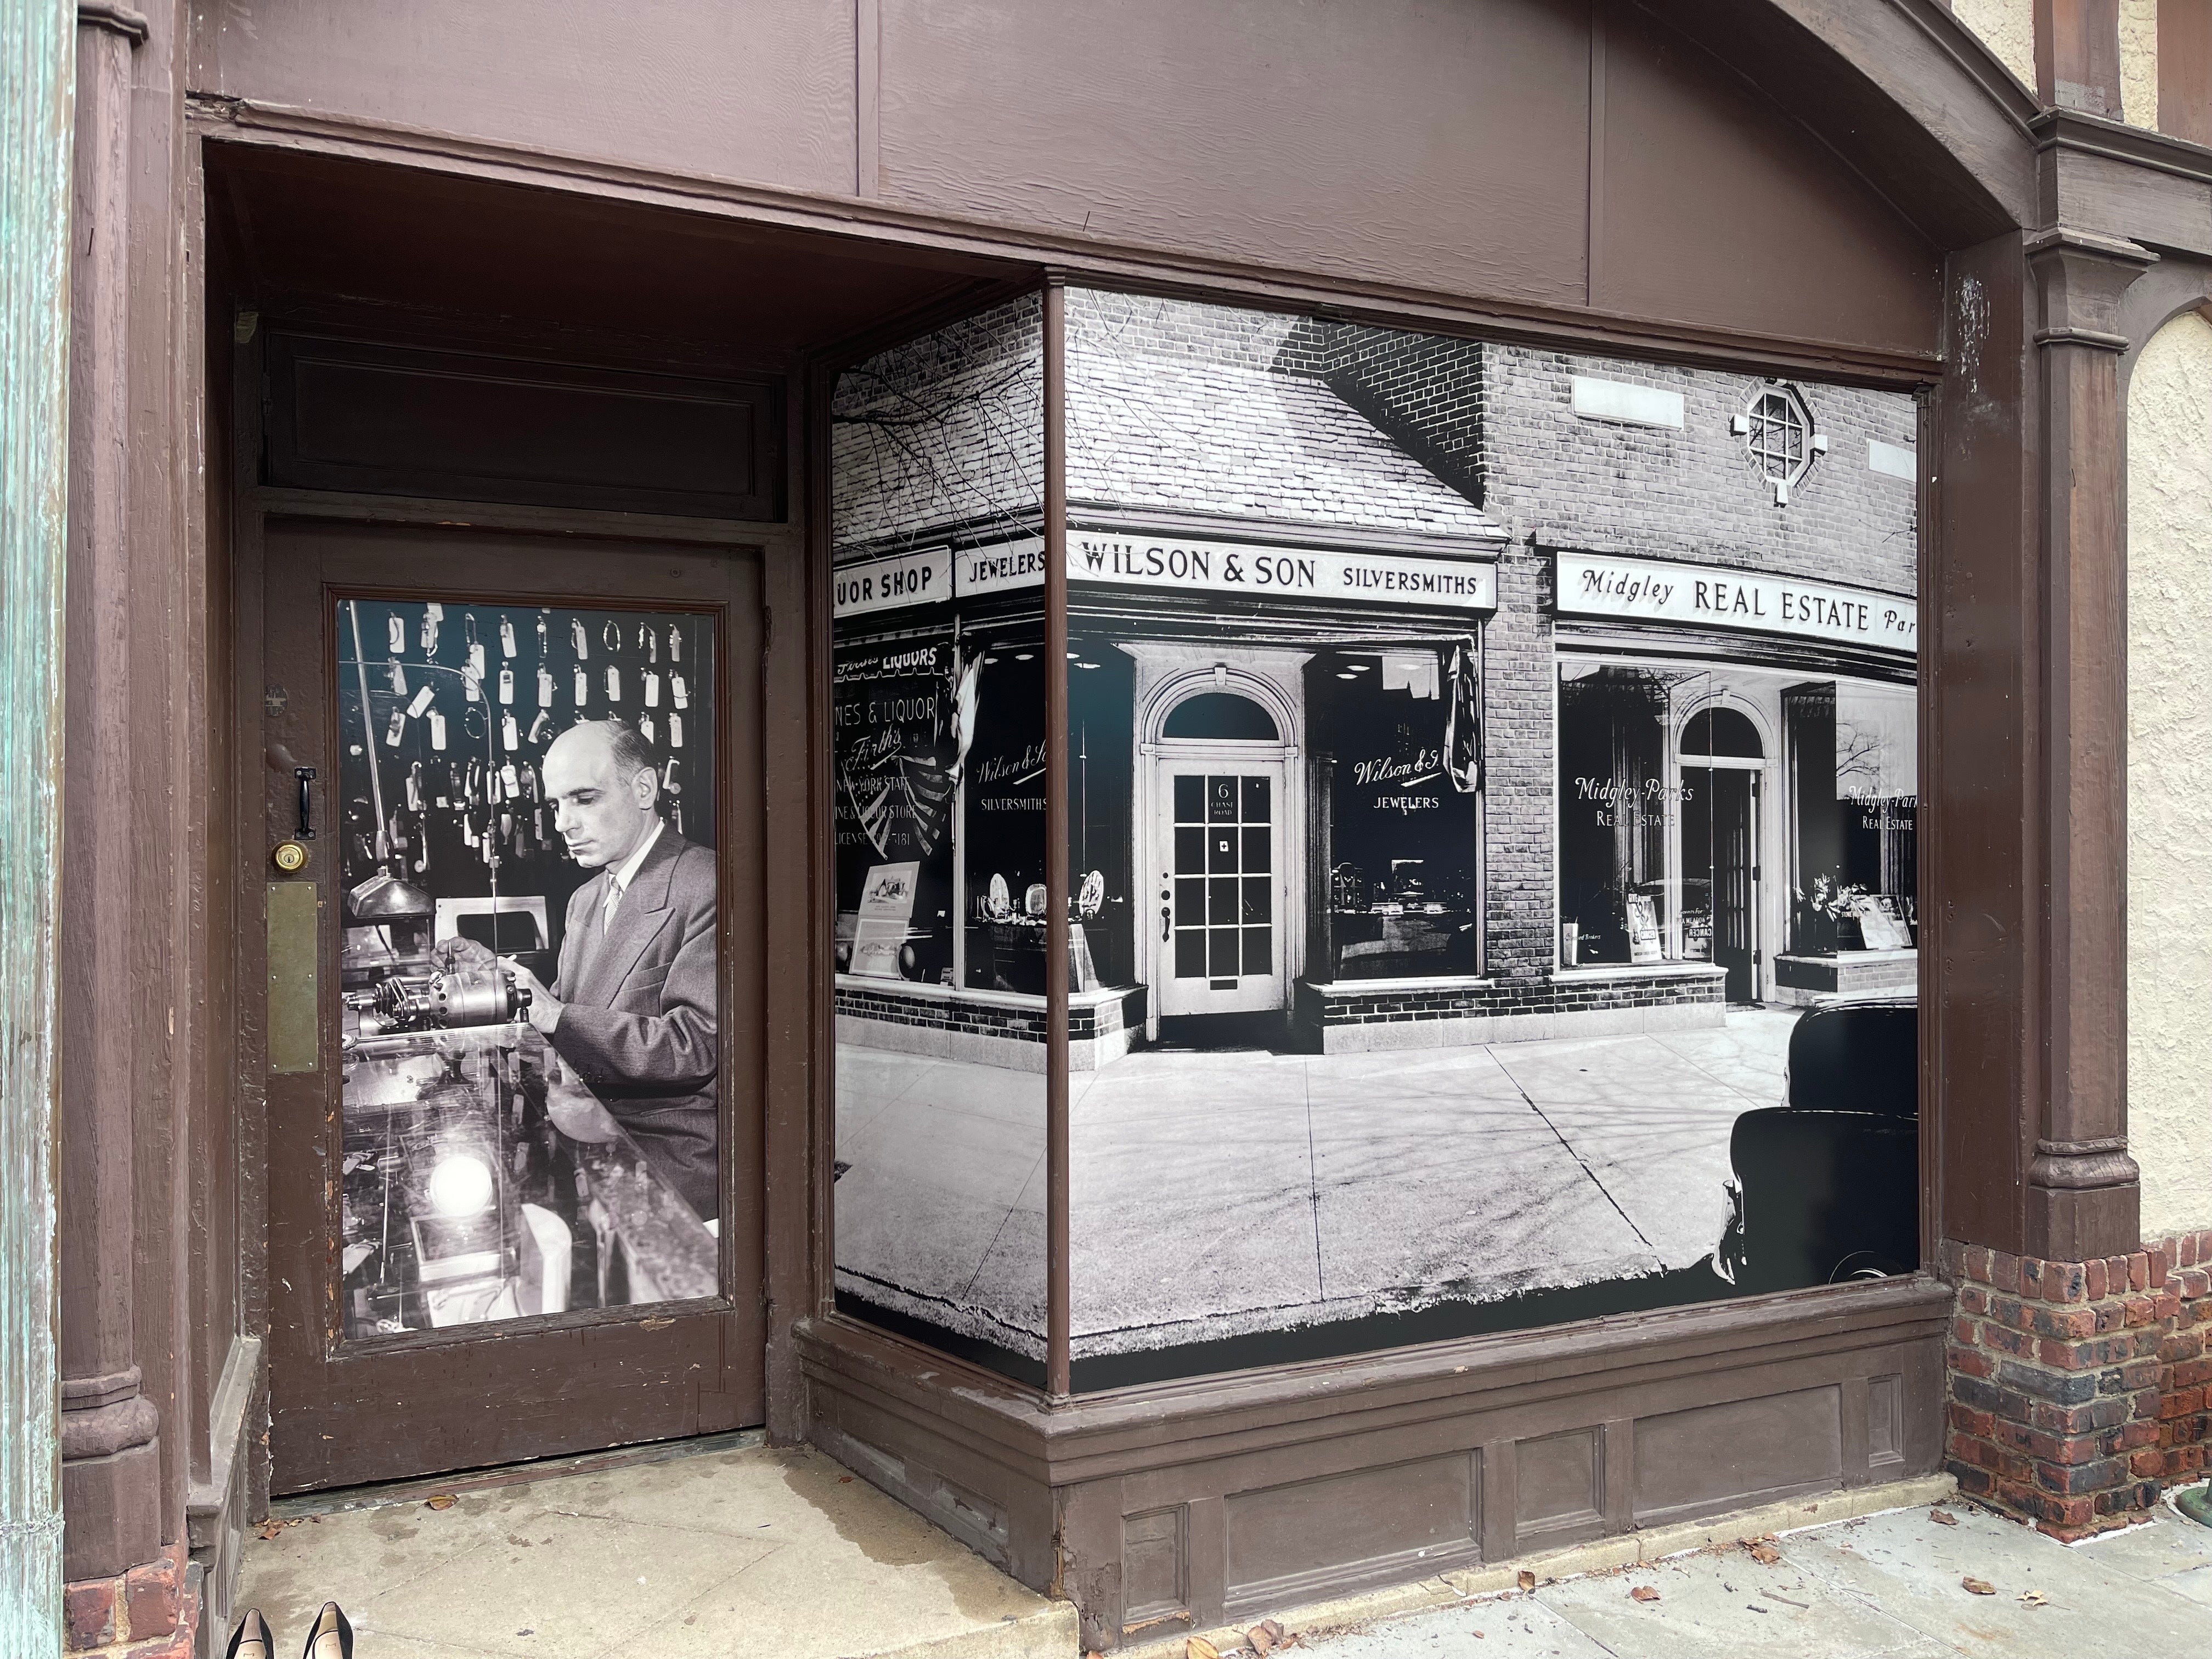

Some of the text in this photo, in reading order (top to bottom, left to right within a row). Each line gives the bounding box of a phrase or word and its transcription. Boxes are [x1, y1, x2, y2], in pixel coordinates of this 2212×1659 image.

[969, 551, 1045, 582] JEWELERS
[1082, 541, 1477, 595] WILSON & SON SILVERSMITHS
[837, 566, 932, 605] UOR SHOP
[1582, 569, 1916, 634] Midgley REAL ESTATE Par
[868, 702, 878, 724] &
[977, 755, 1019, 784] Wilson
[1354, 757, 1411, 786] Wilson
[859, 777, 882, 792] YORK
[1218, 783, 1228, 798] 6
[1575, 777, 1694, 808] Midgley-Parks
[981, 798, 1046, 811] SILVERSMITHS
[1373, 797, 1439, 809] JEWELERS
[1596, 810, 1675, 827] REAL ESTATE
[1863, 815, 1913, 830] REAL ESTATE
